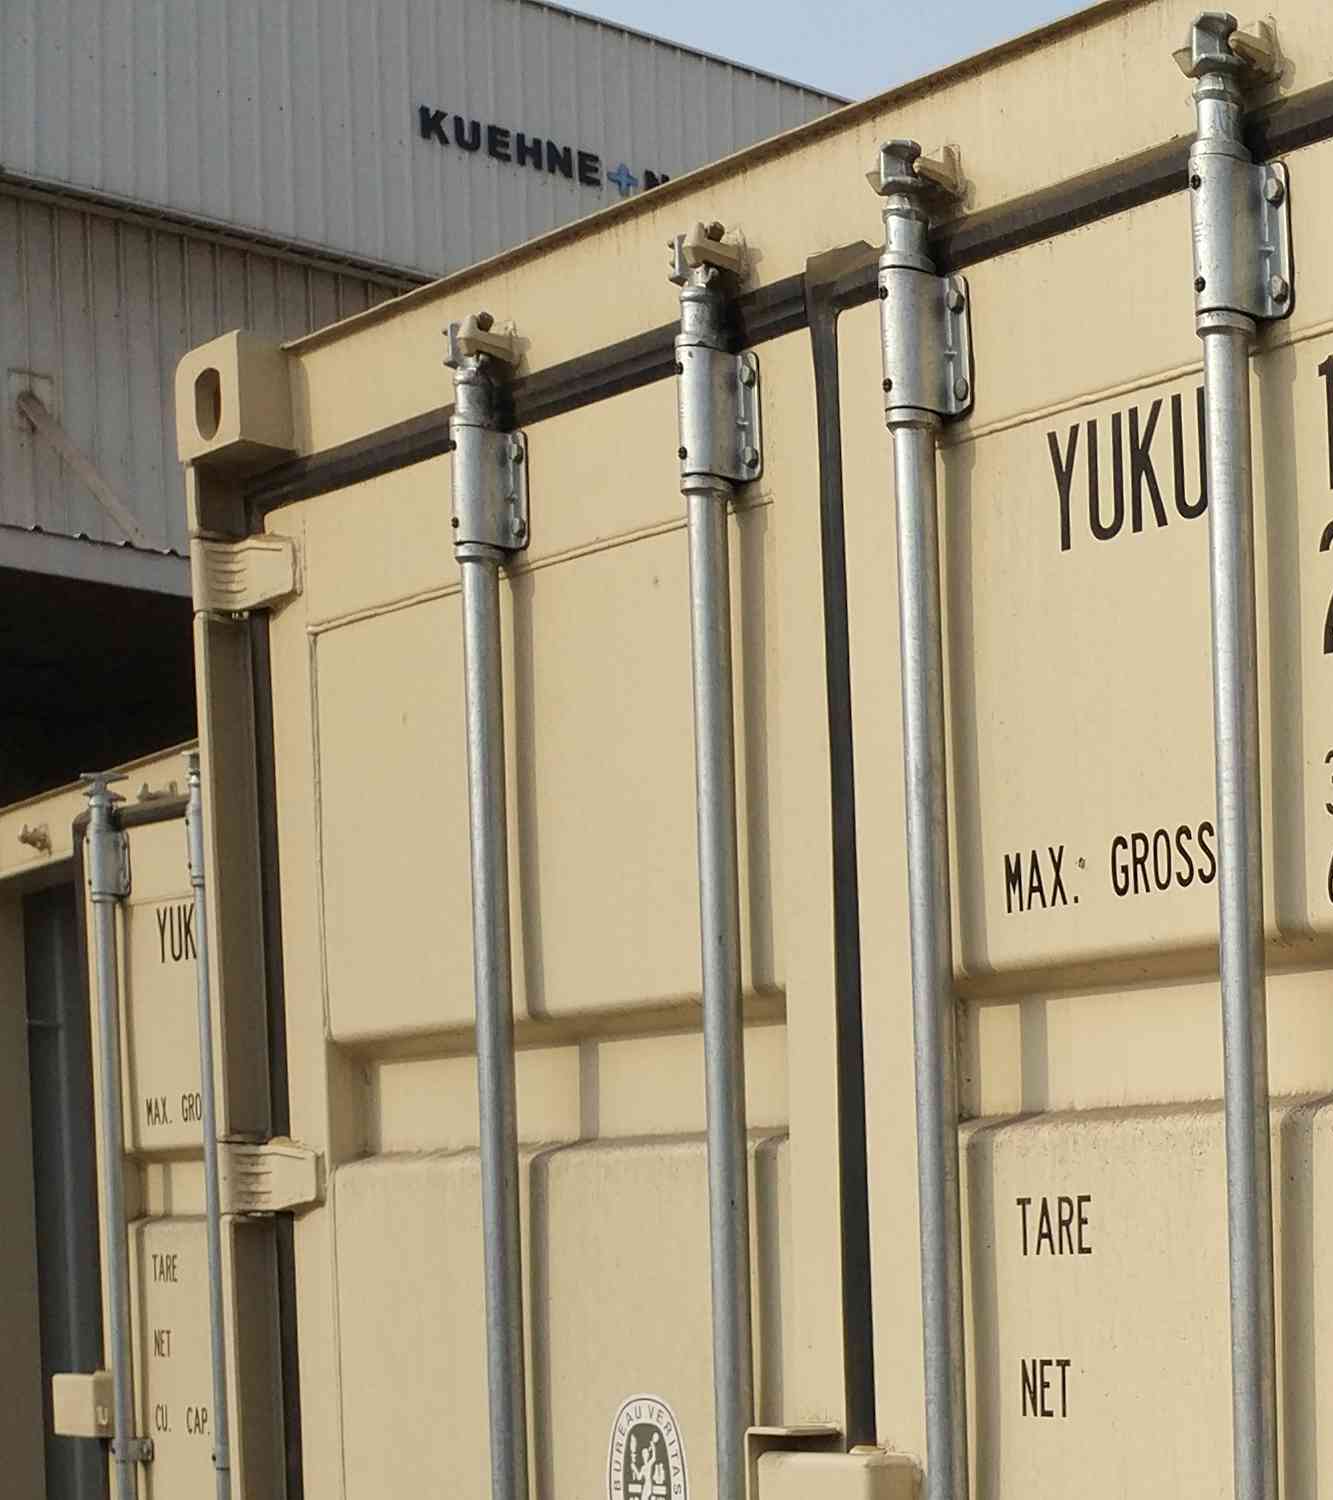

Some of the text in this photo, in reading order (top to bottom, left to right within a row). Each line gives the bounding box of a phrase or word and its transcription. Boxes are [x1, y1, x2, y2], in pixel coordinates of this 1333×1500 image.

[1046, 386, 1210, 553] YUKU
[1003, 821, 1217, 914] MAX. GROSS
[156, 902, 197, 964] YUK
[145, 1095, 173, 1127] MAX.
[1016, 1194, 1093, 1257] TARE
[152, 1254, 178, 1283] TARE
[154, 1329, 172, 1358] NET
[1020, 1358, 1071, 1418] NET
[613, 1404, 682, 1496] BUREAU VERITAS
